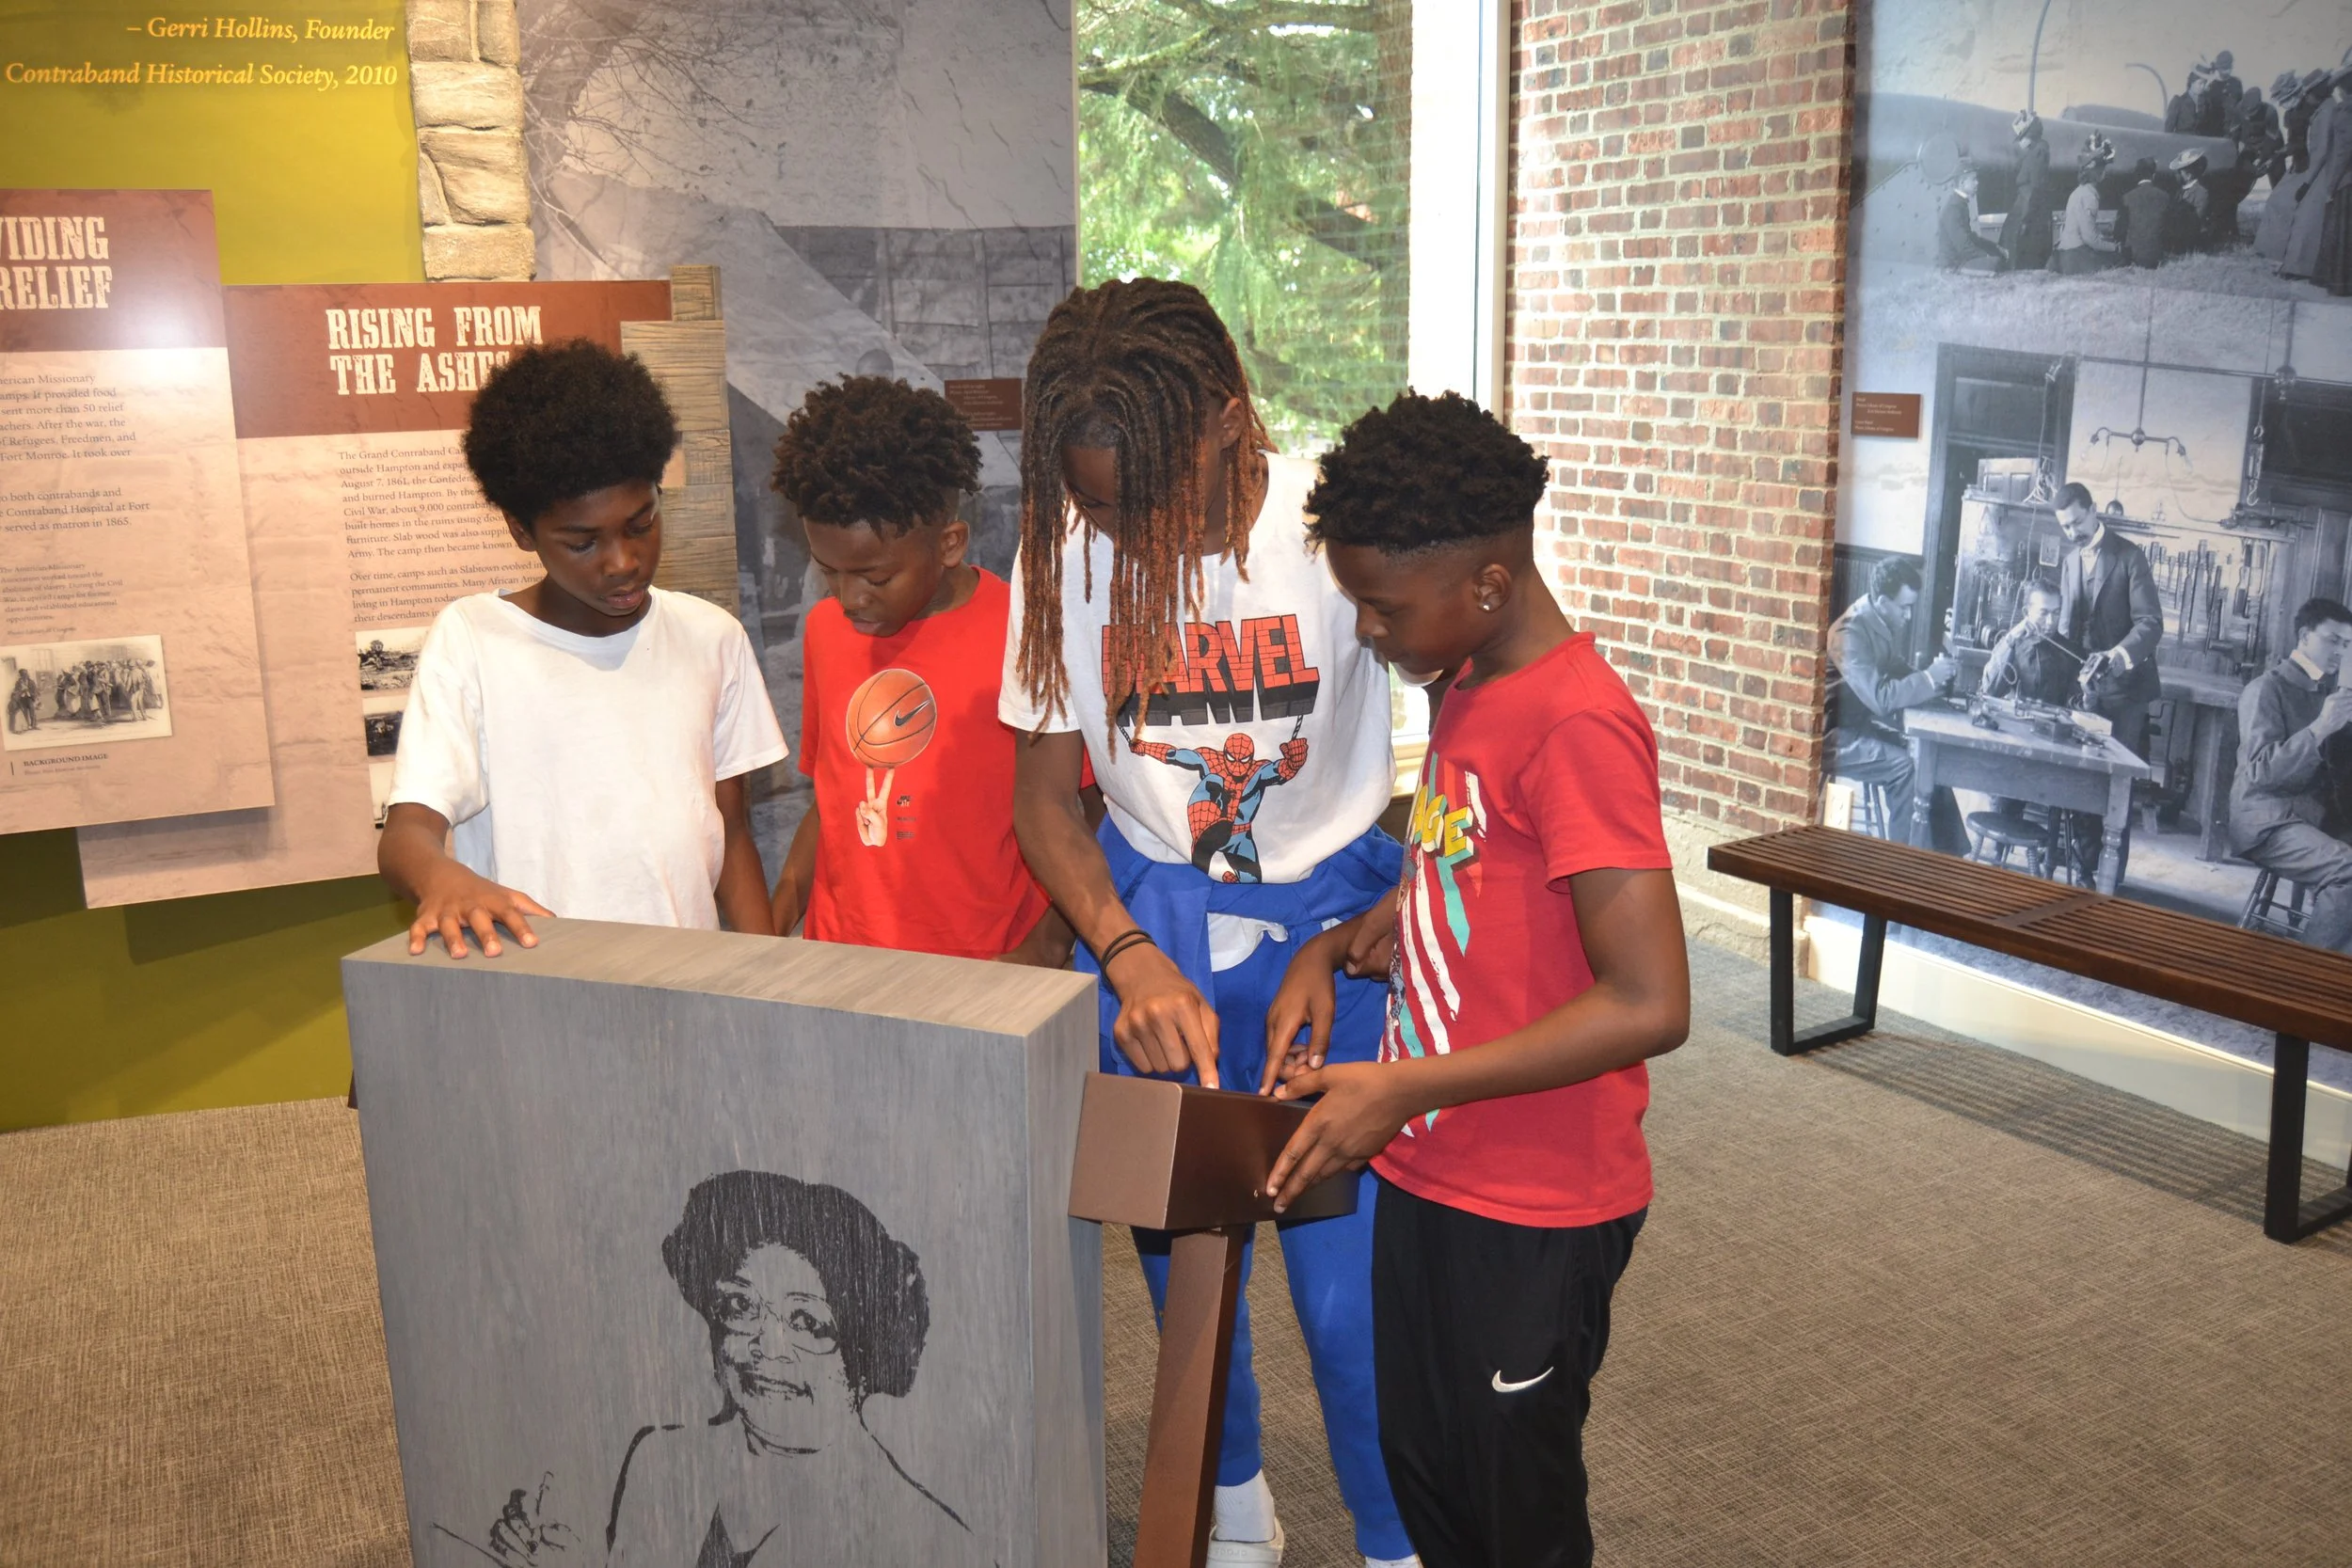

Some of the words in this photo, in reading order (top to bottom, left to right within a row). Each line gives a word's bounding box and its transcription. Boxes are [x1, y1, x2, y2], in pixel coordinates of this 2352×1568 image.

[148, 17, 208, 38] Gerri
[215, 18, 298, 43] Hollins,
[305, 19, 394, 40] Founder
[6, 62, 140, 84] Contraband
[147, 62, 254, 85] Historical
[260, 63, 340, 91] Society,
[345, 65, 397, 86] 2010
[0, 216, 109, 261] IDING
[326, 308, 435, 350] RISING
[453, 306, 543, 347] FROM
[38, 374, 95, 385] Missionary
[330, 354, 396, 395] THE
[33, 390, 40, 400] It
[45, 388, 89, 402] provided
[93, 388, 117, 398] food
[26, 406, 53, 415] more
[56, 404, 79, 414] than
[83, 404, 95, 412] 50
[99, 403, 124, 412] relief
[38, 420, 62, 430] After
[66, 420, 83, 429] the
[109, 418, 125, 427] the
[9, 436, 58, 448] Refugees,
[61, 434, 114, 445] Freedmen,
[117, 432, 135, 441] and
[1, 451, 23, 461] Fort
[25, 451, 70, 461] Monroe.
[72, 450, 81, 459] It
[84, 448, 107, 458] took
[110, 449, 132, 457] over
[339, 451, 357, 460] The
[359, 450, 388, 459] Grand
[391, 447, 445, 458] Contraband
[340, 464, 373, 474] outside
[376, 463, 421, 474] Hampton
[423, 461, 439, 470] and
[342, 479, 373, 489] August
[387, 477, 409, 486] 1861,
[412, 476, 426, 485] the
[429, 473, 473, 484] Confeder
[10, 492, 35, 501] both
[38, 488, 100, 499] contrabands
[103, 486, 121, 498] and
[342, 493, 359, 502] and
[362, 491, 395, 501] burned
[398, 489, 442, 501] Hampton.
[447, 488, 458, 499] By
[461, 486, 474, 497] the
[7, 505, 68, 517] Contraband
[71, 502, 113, 515] Hospital
[116, 503, 126, 512] at
[129, 500, 151, 511] Fort
[343, 506, 365, 516] Civil
[367, 506, 388, 516] War,
[390, 504, 417, 515] about
[419, 503, 444, 514] 9,000
[5, 521, 37, 532] served
[52, 520, 90, 530] matron
[92, 519, 103, 528] in
[106, 516, 132, 526] 1865.
[344, 520, 366, 531] built
[369, 519, 399, 529] homes
[403, 518, 411, 527] in
[414, 517, 428, 527] the
[431, 515, 454, 525] ruins
[457, 515, 482, 525] using
[346, 534, 390, 546] furniture.
[393, 531, 413, 542] Slab
[415, 530, 439, 540] wood
[442, 530, 458, 539] was
[461, 528, 479, 537] also
[348, 549, 374, 559] Army.
[376, 546, 395, 557] The
[397, 546, 421, 557] camp
[424, 544, 445, 554] then
[448, 543, 480, 552] became
[482, 541, 513, 550] known
[350, 572, 371, 581] Over
[373, 570, 395, 580] time,
[397, 569, 425, 579] camps
[427, 566, 447, 577] such
[460, 563, 500, 575] Slabtown
[501, 561, 532, 571] evolved
[351, 585, 399, 598] permanent
[401, 580, 460, 593] communities.
[462, 579, 486, 588] Many
[488, 577, 518, 586] African
[352, 599, 377, 610] living
[379, 598, 388, 607] in
[390, 596, 433, 608] Hampton
[354, 612, 375, 623] their
[377, 610, 429, 622] descendants
[24, 755, 81, 767] BACKGROUND
[82, 752, 108, 762] IMAGE
